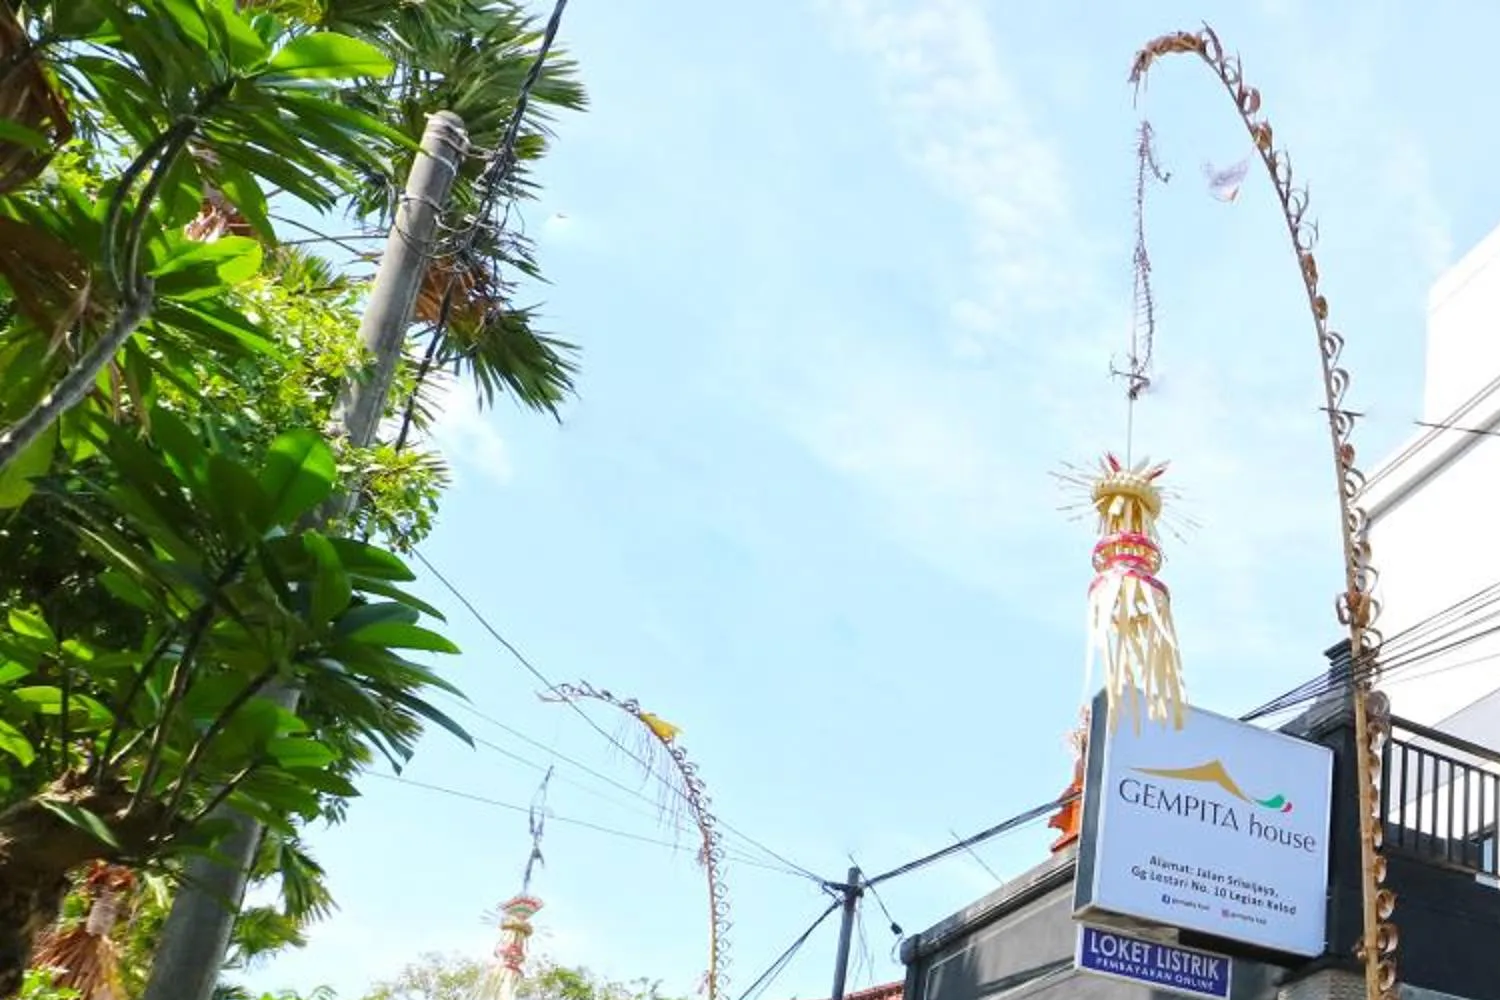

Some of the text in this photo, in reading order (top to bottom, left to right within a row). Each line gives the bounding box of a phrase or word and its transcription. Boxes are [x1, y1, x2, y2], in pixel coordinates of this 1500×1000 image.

[1118, 778, 1316, 852] GEMPITA house
[1214, 886, 1227, 899] 10
[1229, 891, 1264, 907] Legian
[1091, 931, 1220, 981] LOKET LISTRIK
[1095, 957, 1214, 992] PEMBAYARAN ONLINE
